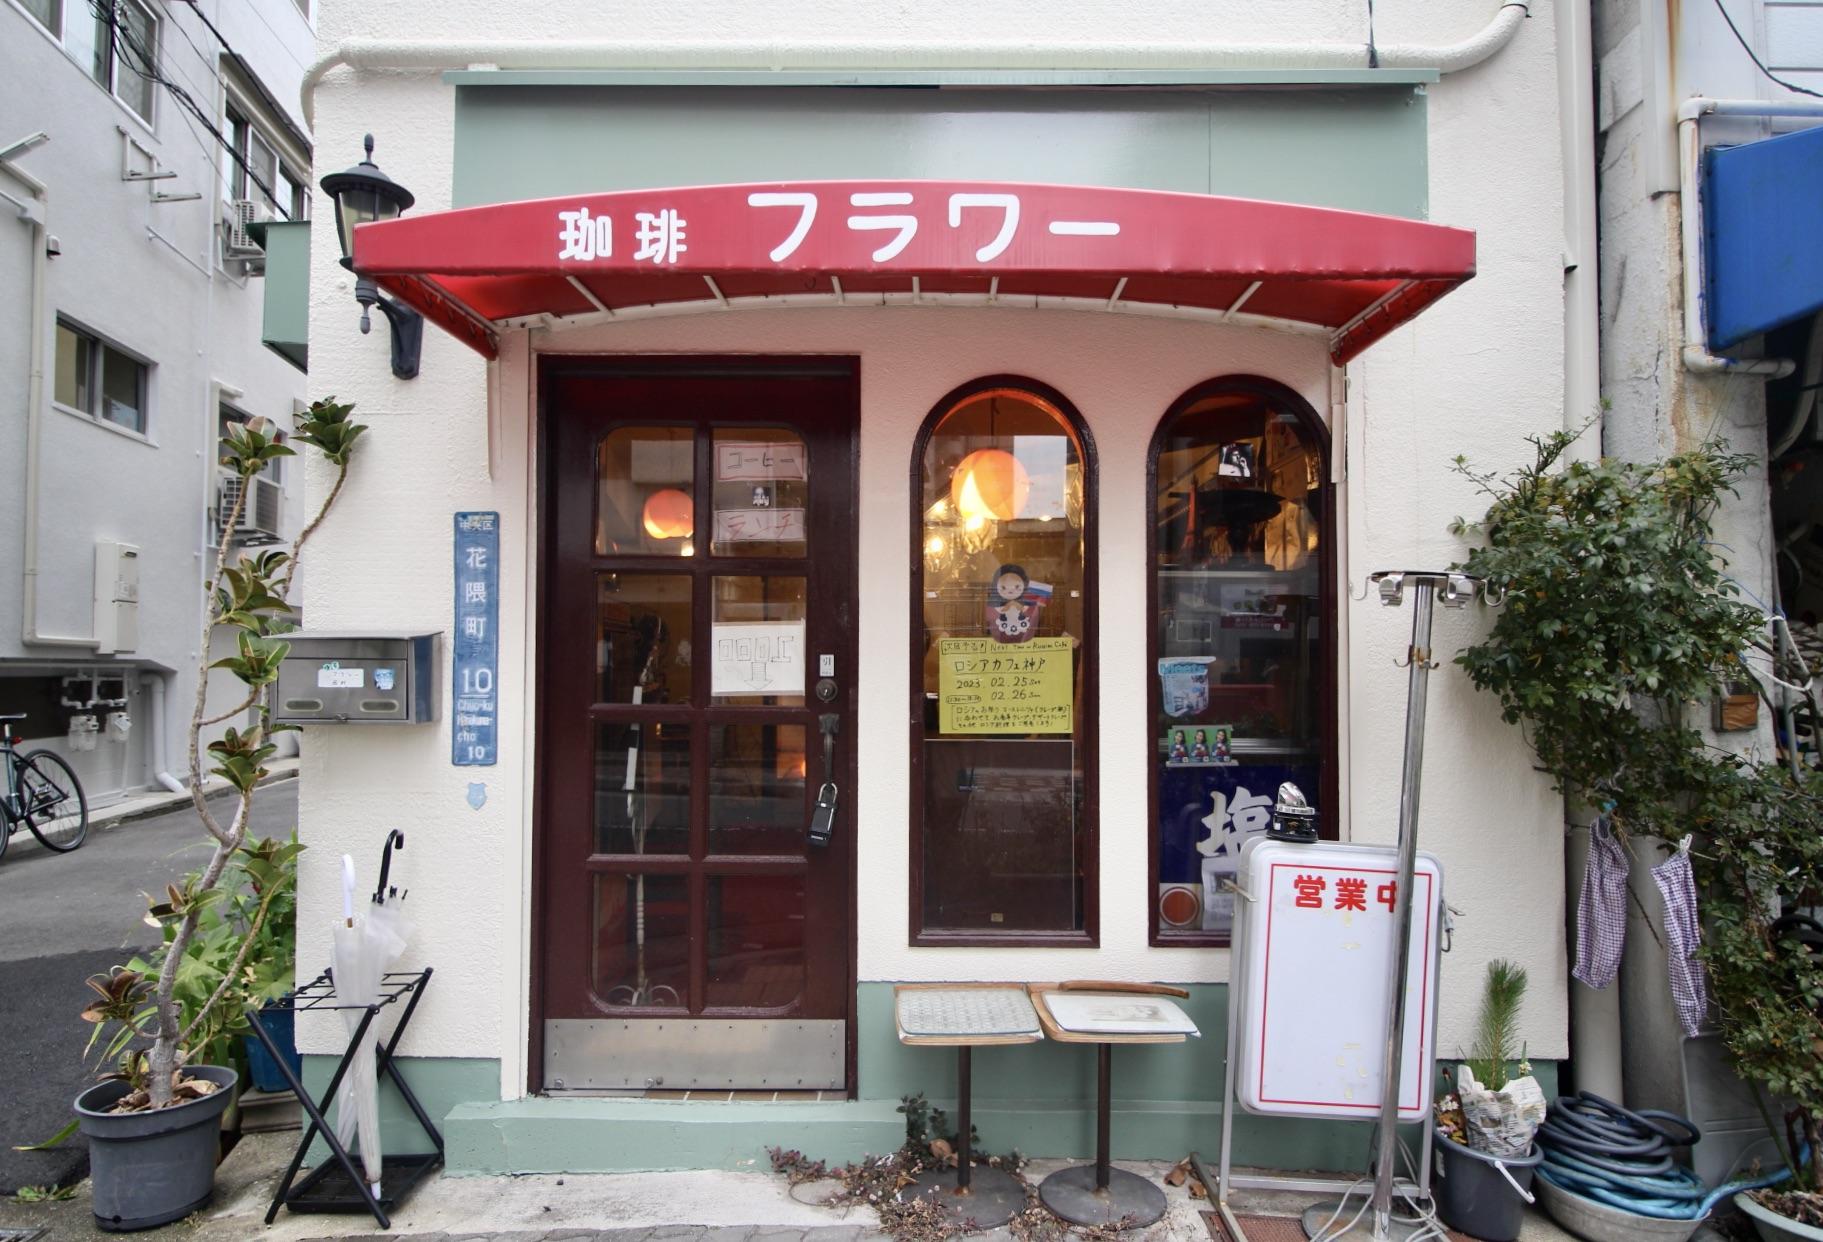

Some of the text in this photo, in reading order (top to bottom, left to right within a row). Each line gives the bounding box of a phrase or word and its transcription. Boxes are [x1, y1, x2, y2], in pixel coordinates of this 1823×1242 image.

[558, 192, 1120, 264] 珈琲 フラワー
[727, 451, 795, 469] コーヒー
[727, 513, 795, 541] ランチ
[465, 547, 488, 640] 花隈町
[955, 658, 1046, 672] ロシアカフェ神戸
[462, 667, 493, 693] 10
[468, 745, 485, 760] 10
